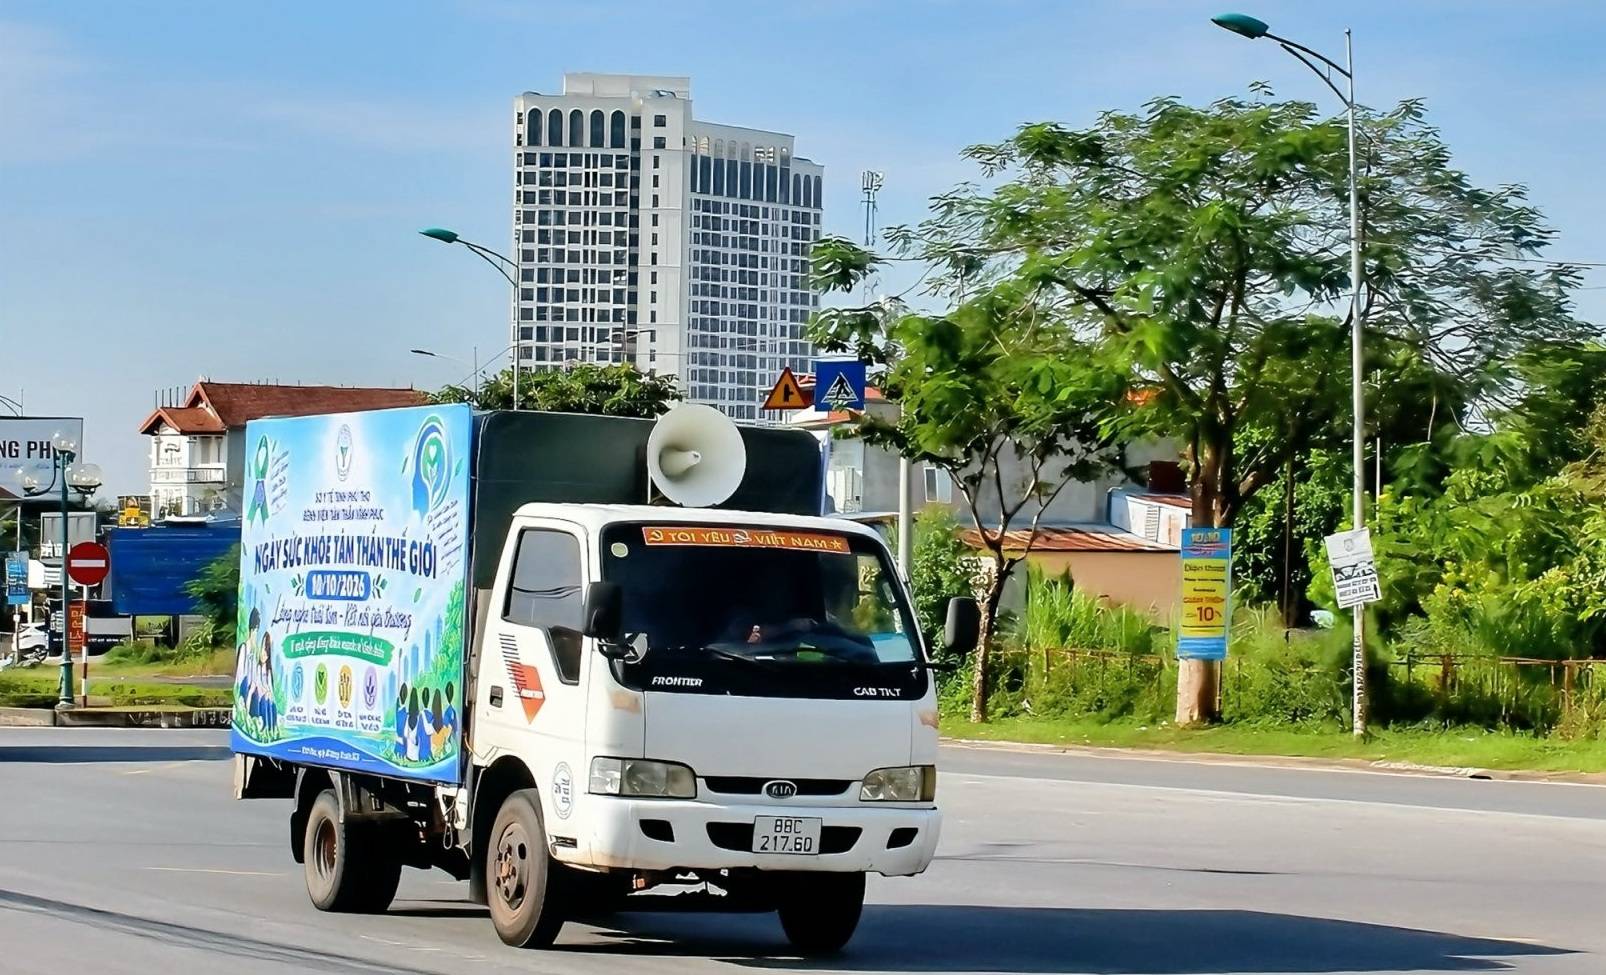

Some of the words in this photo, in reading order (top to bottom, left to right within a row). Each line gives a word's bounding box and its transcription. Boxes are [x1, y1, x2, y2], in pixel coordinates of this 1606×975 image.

[791, 536, 828, 550] NAM
[1196, 607, 1215, 622] 10
[853, 686, 877, 696] CAB
[878, 687, 901, 697] TILT
[774, 818, 803, 833] 88C
[759, 835, 813, 852] 217.60
